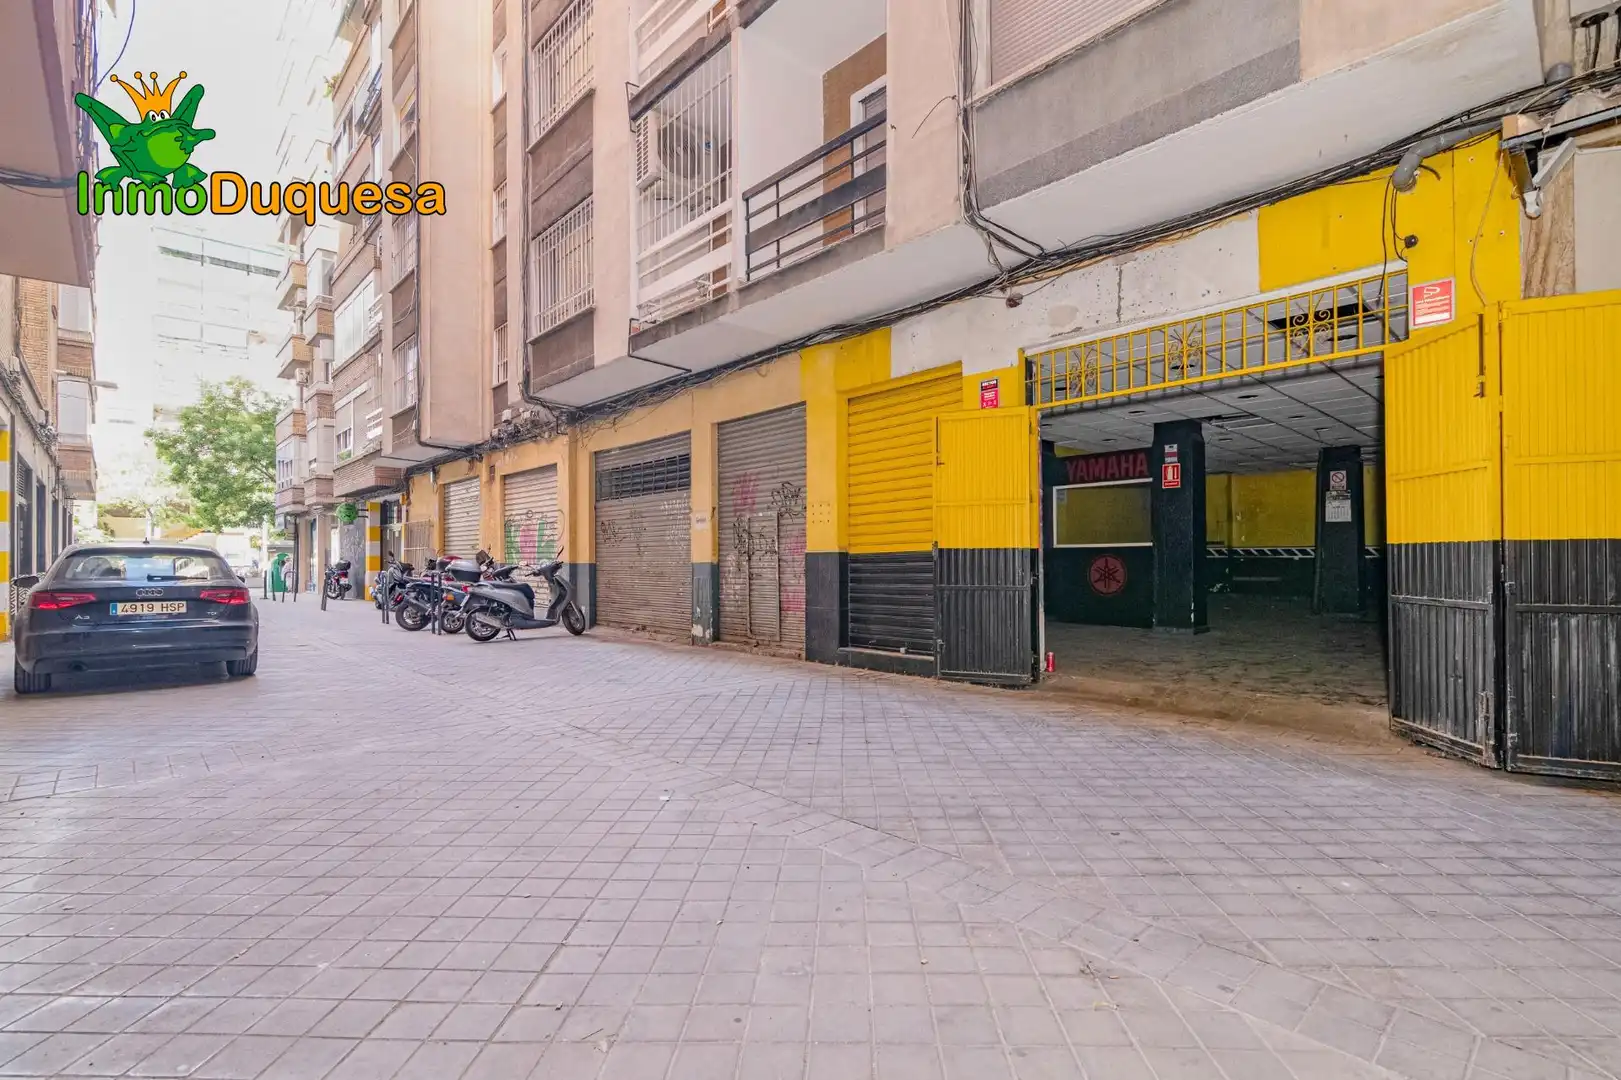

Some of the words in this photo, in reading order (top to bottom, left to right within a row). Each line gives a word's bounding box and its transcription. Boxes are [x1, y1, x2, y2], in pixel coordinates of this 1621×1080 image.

[1065, 452, 1149, 482] YAMAHA
[120, 603, 155, 614] 4919
[160, 602, 185, 613] HSP
